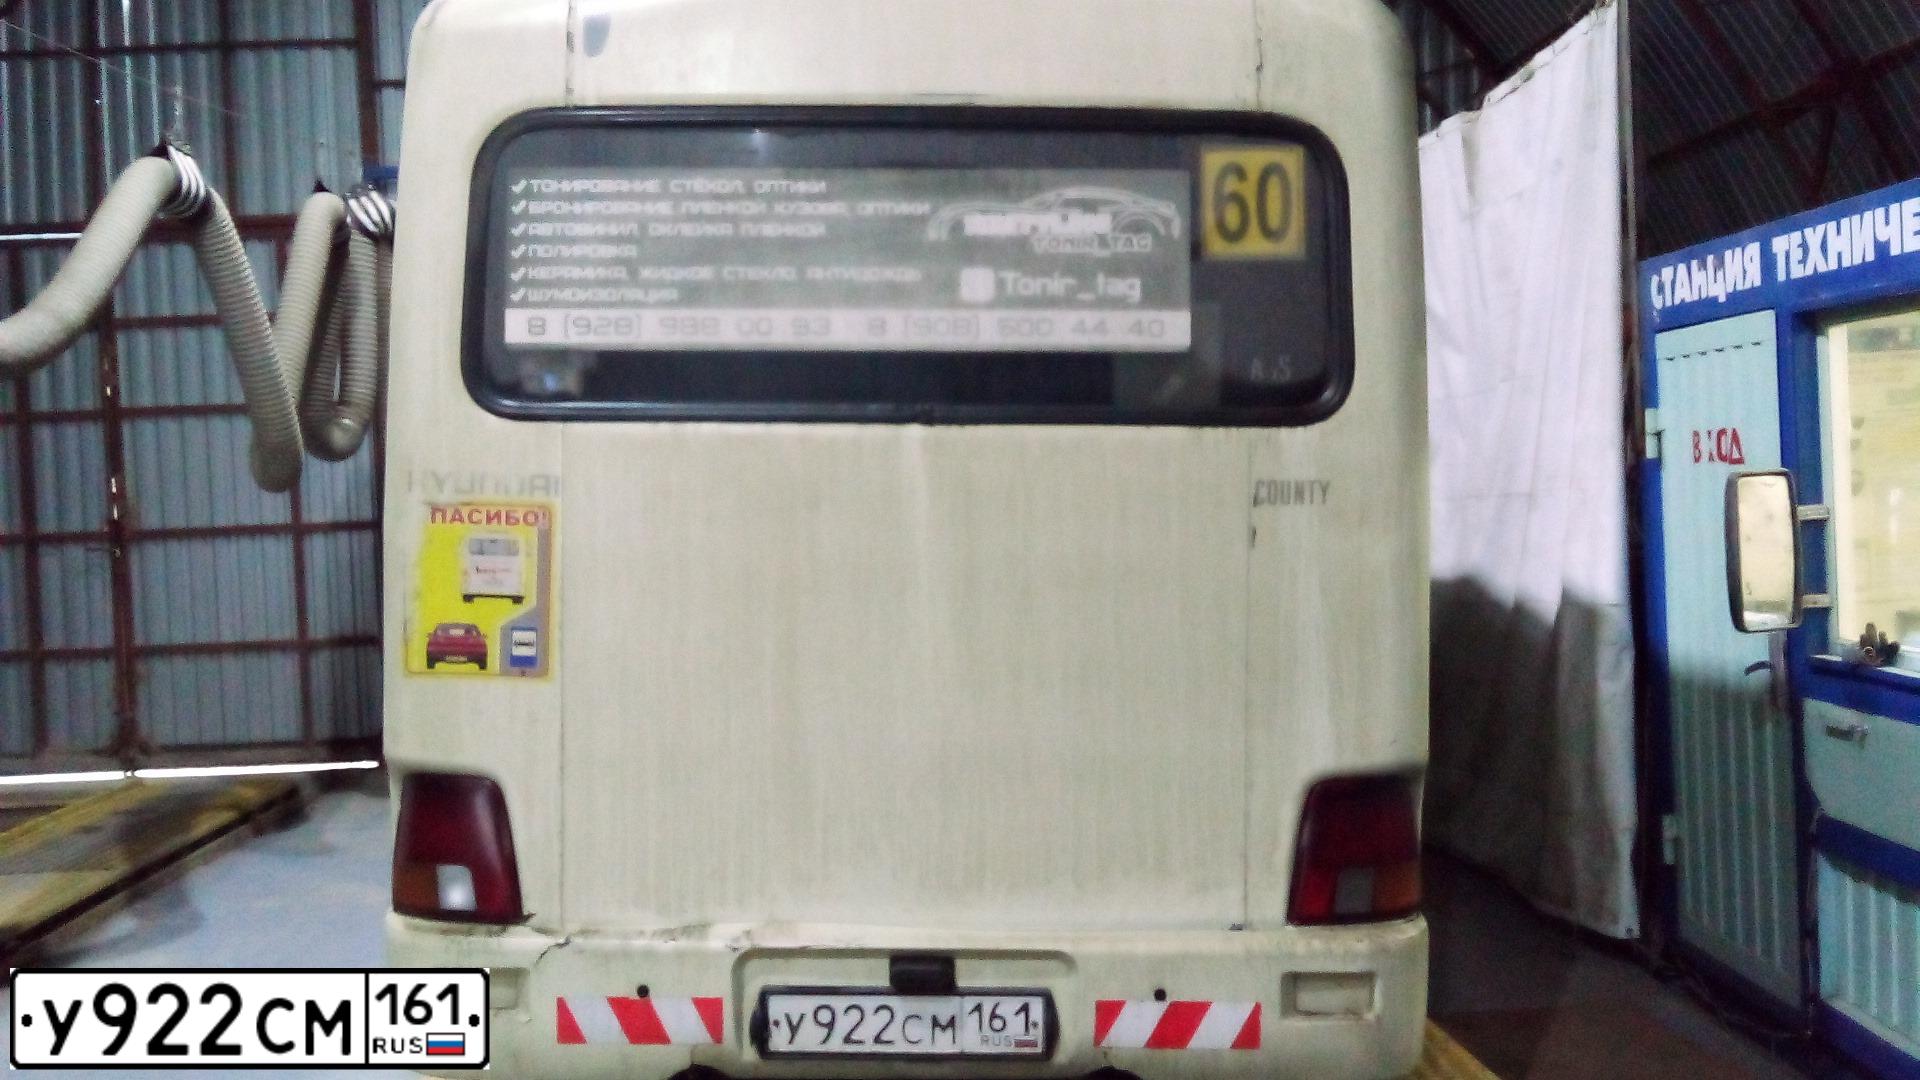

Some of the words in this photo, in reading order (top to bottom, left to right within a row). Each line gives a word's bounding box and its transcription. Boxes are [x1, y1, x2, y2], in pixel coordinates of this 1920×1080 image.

[1212, 161, 1293, 245] 60
[1651, 241, 1762, 310] СТАНЦИЯ
[1772, 196, 1920, 282] ТЕХНИЧЕ
[999, 270, 1142, 303] Tonir_tag
[527, 316, 547, 336] 8
[737, 316, 775, 337] 00
[868, 317, 888, 338] 8
[1071, 317, 1110, 338] 44
[1127, 318, 1166, 338] 40
[1253, 479, 1330, 506] COUNTY
[784, 1003, 957, 1046] У922СМ
[967, 1001, 1032, 1036] 161
[979, 1034, 1013, 1048] RUS
